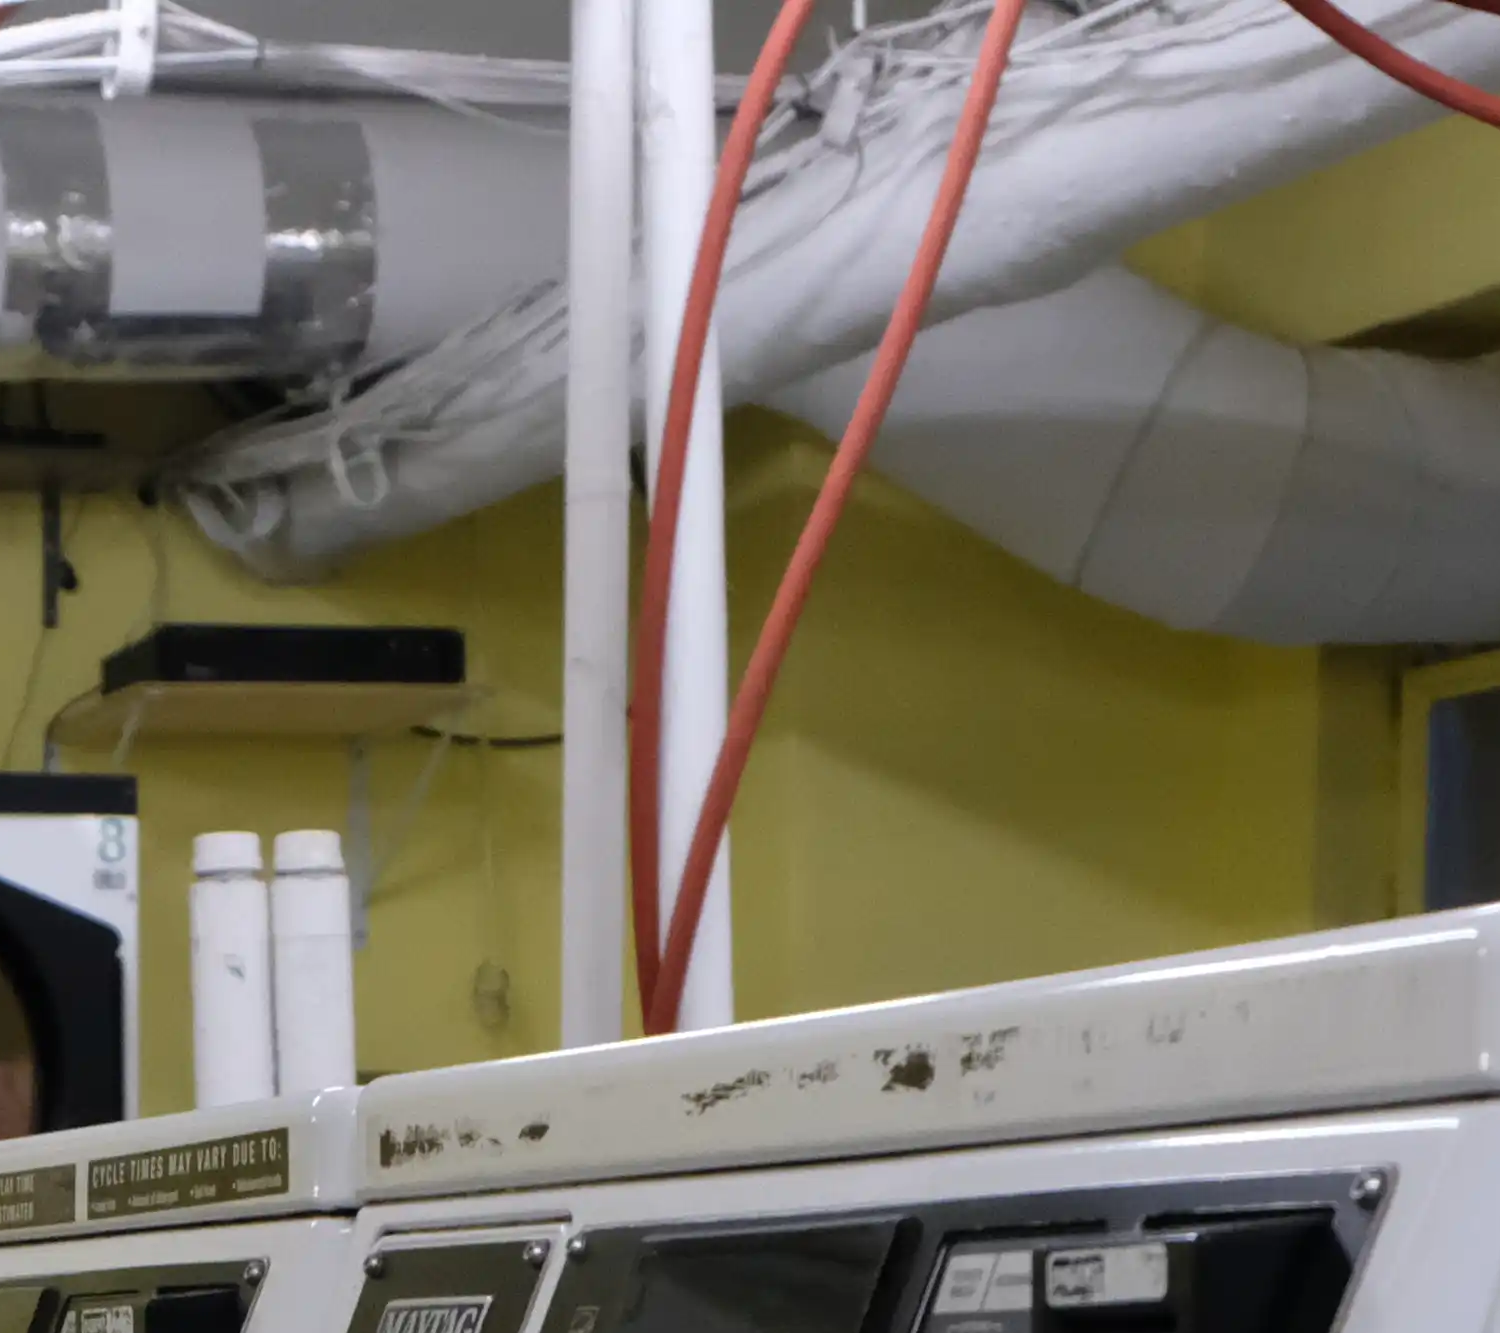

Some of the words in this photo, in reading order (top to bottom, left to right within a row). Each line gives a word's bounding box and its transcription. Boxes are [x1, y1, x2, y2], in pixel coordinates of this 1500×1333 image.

[97, 816, 127, 863] 8
[91, 1161, 125, 1189] CYCLE
[130, 1156, 164, 1183] TIMES
[168, 1150, 192, 1177] MAY
[196, 1143, 227, 1173] VARY
[232, 1139, 256, 1168] DUE
[260, 1134, 282, 1162] TO:
